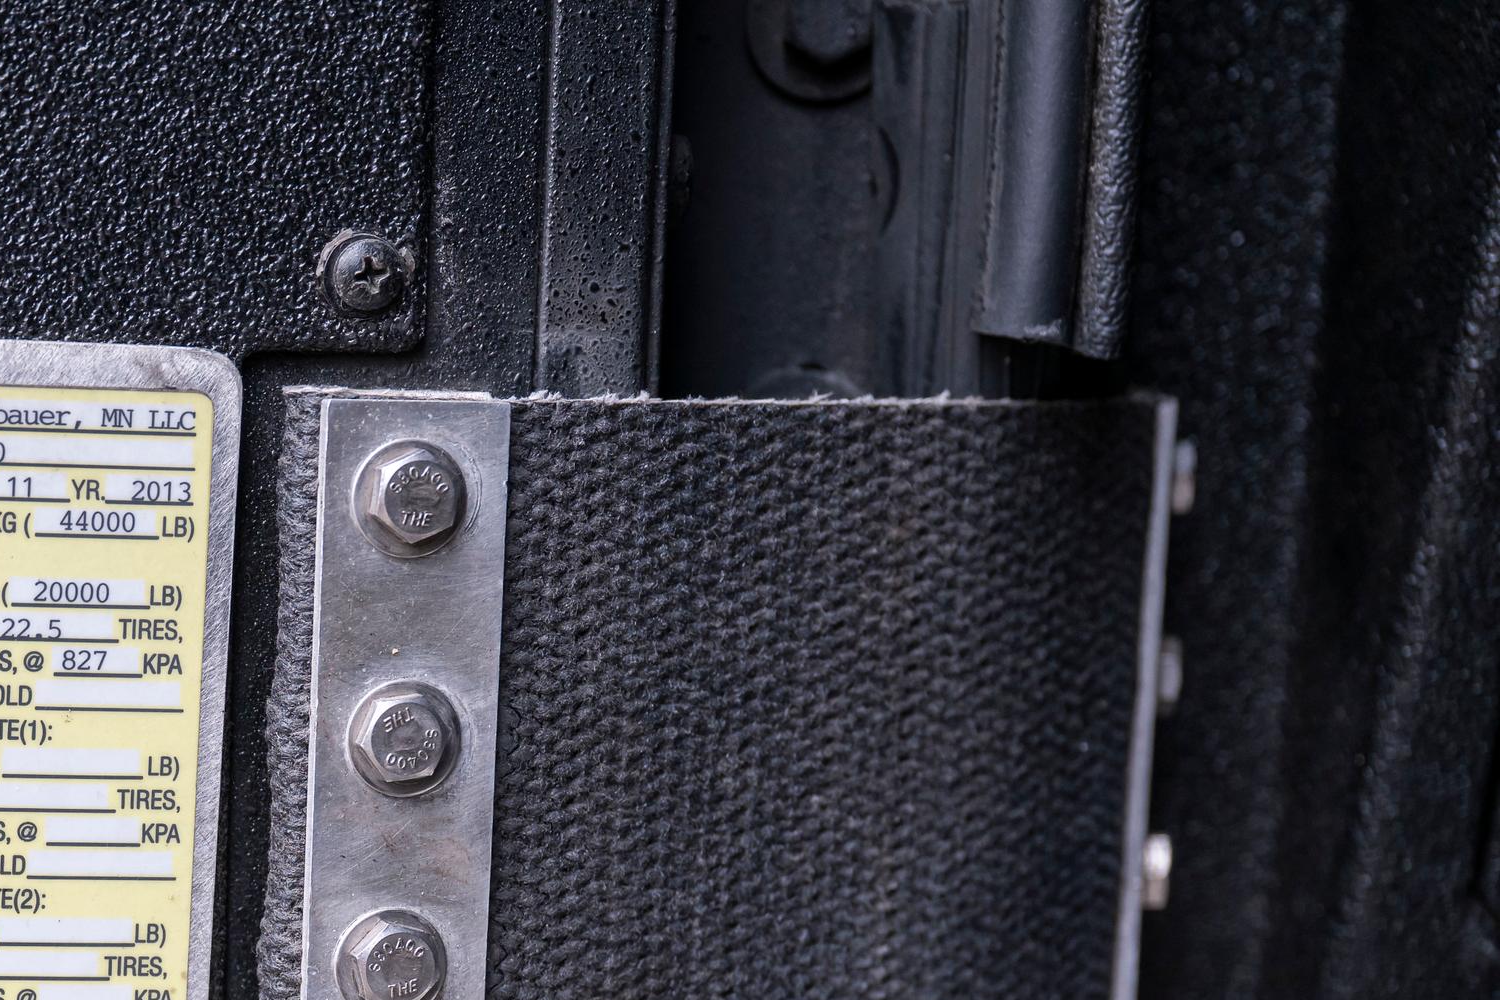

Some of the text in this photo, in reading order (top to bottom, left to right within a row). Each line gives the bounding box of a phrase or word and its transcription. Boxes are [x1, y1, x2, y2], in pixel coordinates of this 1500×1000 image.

[101, 409, 133, 428] MN
[148, 410, 196, 430] LLC
[7, 477, 33, 497] 11
[72, 480, 105, 500] YR.
[132, 481, 191, 501] 2013
[60, 512, 135, 532] 44000
[162, 517, 194, 541] LB)
[33, 583, 109, 602] 20000
[150, 586, 182, 610] LB)
[2, 620, 61, 640] 22.5
[119, 620, 183, 643] TIRES,
[24, 651, 44, 671] @
[62, 651, 107, 670] 827
[144, 654, 182, 674] KPA
[148, 757, 180, 780] LB)
[118, 790, 180, 813] TIRES,
[17, 822, 37, 842] @
[141, 824, 180, 844] KPA
[135, 924, 166, 948] LB)
[104, 957, 167, 979] TIRES,
